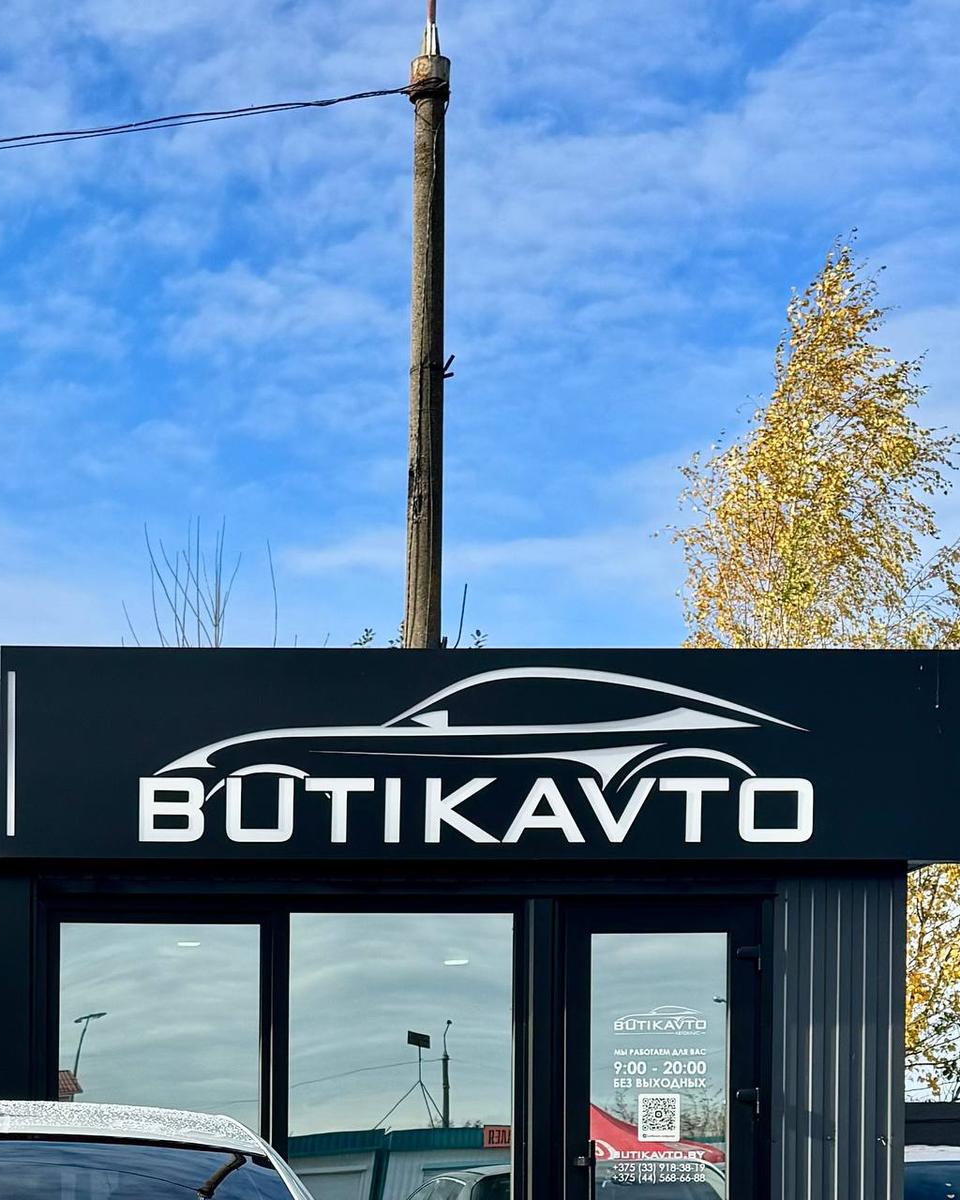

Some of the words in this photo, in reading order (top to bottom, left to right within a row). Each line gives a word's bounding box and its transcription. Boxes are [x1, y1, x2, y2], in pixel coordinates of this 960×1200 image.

[139, 777, 814, 842] BUTIKAVTO
[614, 1020, 707, 1031] BUTIKAVTO
[614, 1048, 628, 1056] МЫ
[629, 1048, 670, 1056] РАБОТАЕМ
[672, 1048, 689, 1057] ДЛЯ
[690, 1048, 706, 1056] ВАС
[613, 1061, 646, 1075] 9:00
[663, 1061, 707, 1075] 20:00
[613, 1078, 633, 1088] БЕЗ
[636, 1078, 706, 1089] ВЫХОДНЫХ
[614, 1151, 706, 1159] BUTIKAVTO.BY
[613, 1162, 636, 1172] +375
[638, 1162, 656, 1173] (33)
[659, 1162, 706, 1172] 918-38-19
[613, 1173, 636, 1183] +375
[638, 1173, 656, 1184] (44)
[659, 1173, 706, 1183] 568-66-88
